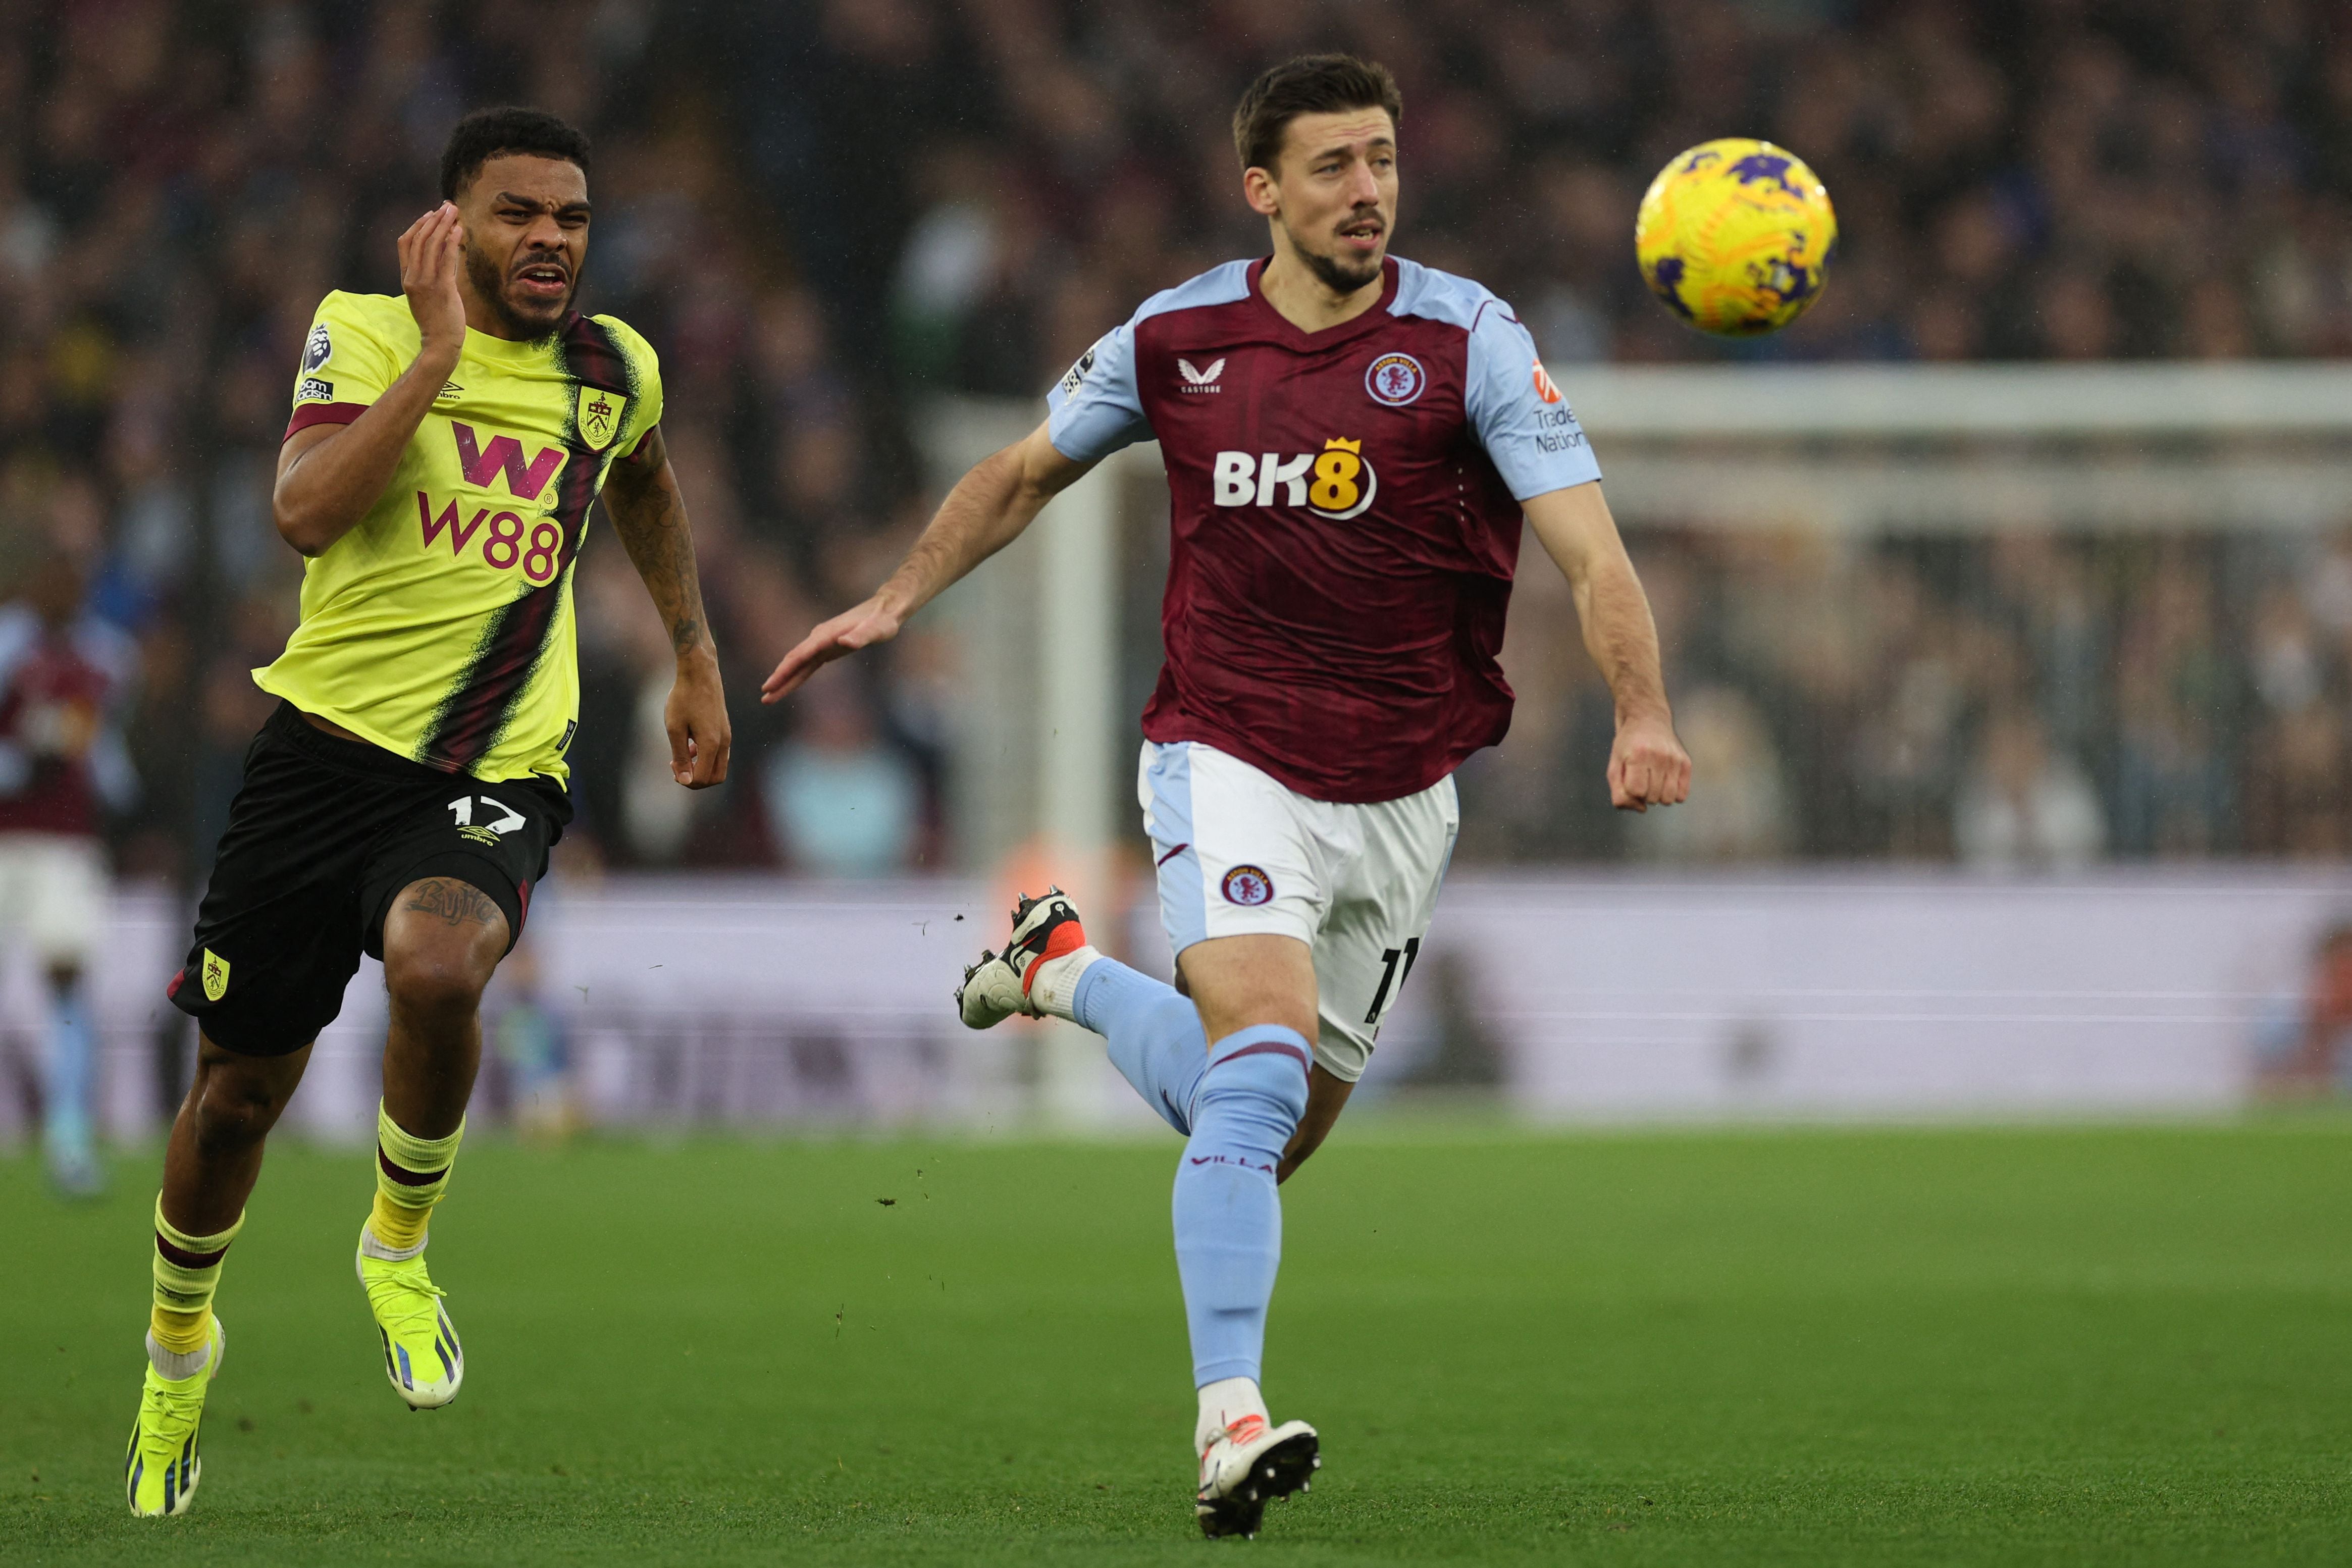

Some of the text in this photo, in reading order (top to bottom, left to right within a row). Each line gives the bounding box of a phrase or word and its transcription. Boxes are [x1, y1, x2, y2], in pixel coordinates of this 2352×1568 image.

[296, 389, 332, 403] racism
[300, 380, 327, 392] oom
[1180, 385, 1221, 394] CASTORE
[1533, 405, 1576, 429] Trade
[451, 420, 564, 501] W
[1213, 450, 1362, 511] BK8
[417, 490, 559, 582] W88
[447, 795, 527, 835] 17
[461, 833, 494, 847] umbro
[1364, 937, 1420, 1024] 11
